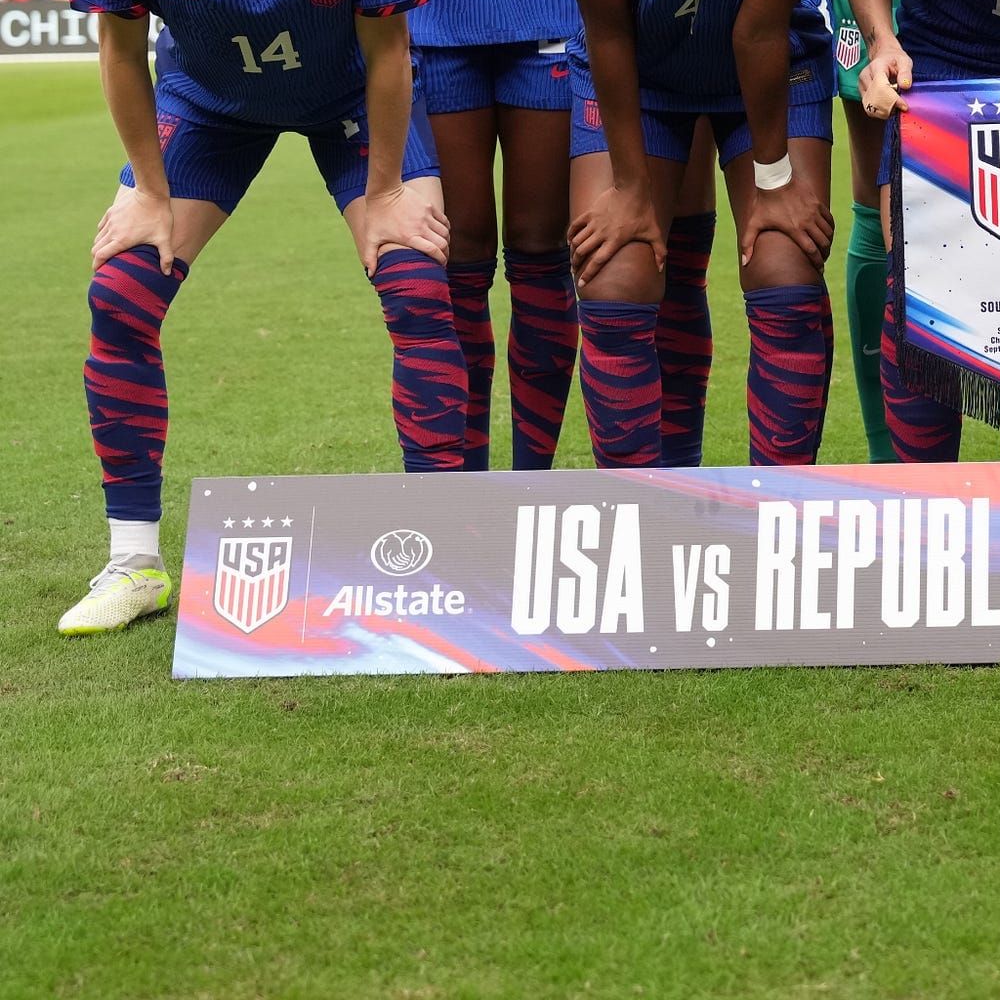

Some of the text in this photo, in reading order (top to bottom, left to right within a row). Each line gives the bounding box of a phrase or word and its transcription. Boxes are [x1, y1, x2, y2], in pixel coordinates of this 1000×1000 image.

[232, 31, 302, 73] 14
[840, 29, 860, 46] USA
[223, 541, 289, 578] USA
[511, 503, 645, 635] USA
[672, 544, 731, 632] VS
[322, 584, 465, 617] Allstate
